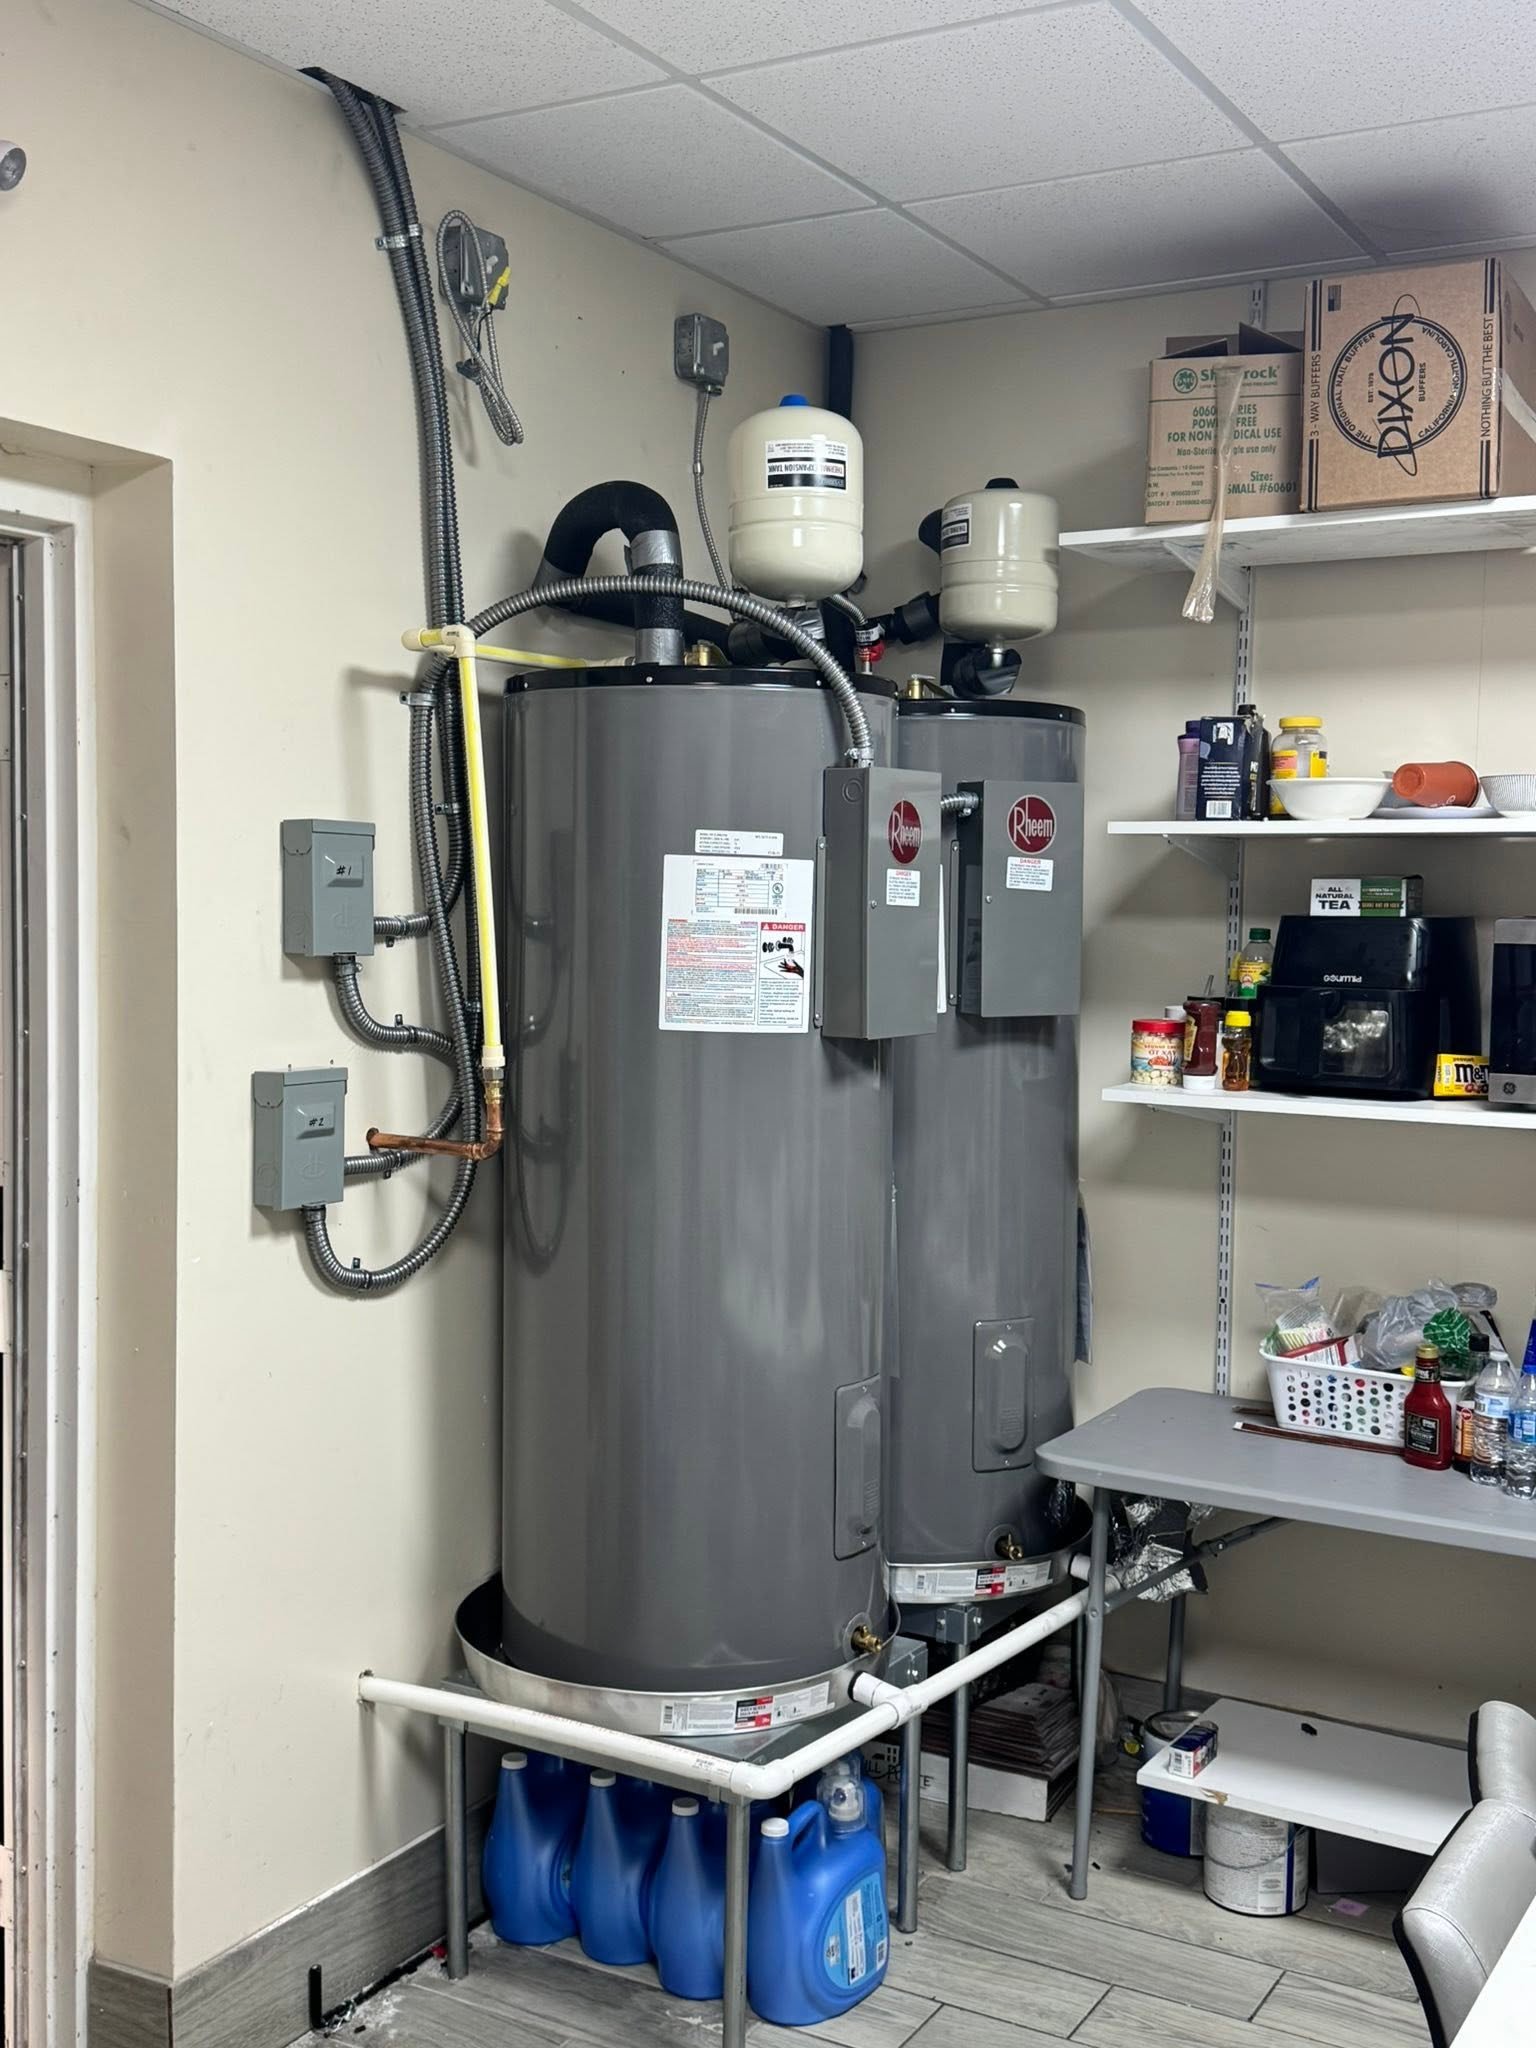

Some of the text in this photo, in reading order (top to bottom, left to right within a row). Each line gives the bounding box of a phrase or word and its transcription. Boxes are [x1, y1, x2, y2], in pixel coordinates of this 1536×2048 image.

[1200, 366, 1278, 382] Shrock
[1311, 354, 1321, 399] BUFFERS
[1418, 362, 1426, 402] BUFFERS
[1418, 326, 1460, 438] CALIFORNIA NORTH CAROLINA
[1480, 318, 1494, 438] NOTHING BUT THE BEST
[1335, 332, 1376, 443] THE ORIGINAL NAIL BUFFER
[1377, 313, 1415, 458] DIXON
[1311, 399, 1320, 424] WAY
[1236, 417, 1257, 427] FREE
[1167, 428, 1281, 442] FOR NON DICAL USE
[1260, 445, 1277, 455] only
[1250, 471, 1273, 482] Size:
[1227, 482, 1297, 494] SMALL #60601
[890, 800, 921, 855] Rheem
[1013, 797, 1053, 845] Rheem
[336, 865, 352, 876] #1
[1318, 900, 1351, 910] TEA
[309, 1117, 324, 1127] #2
